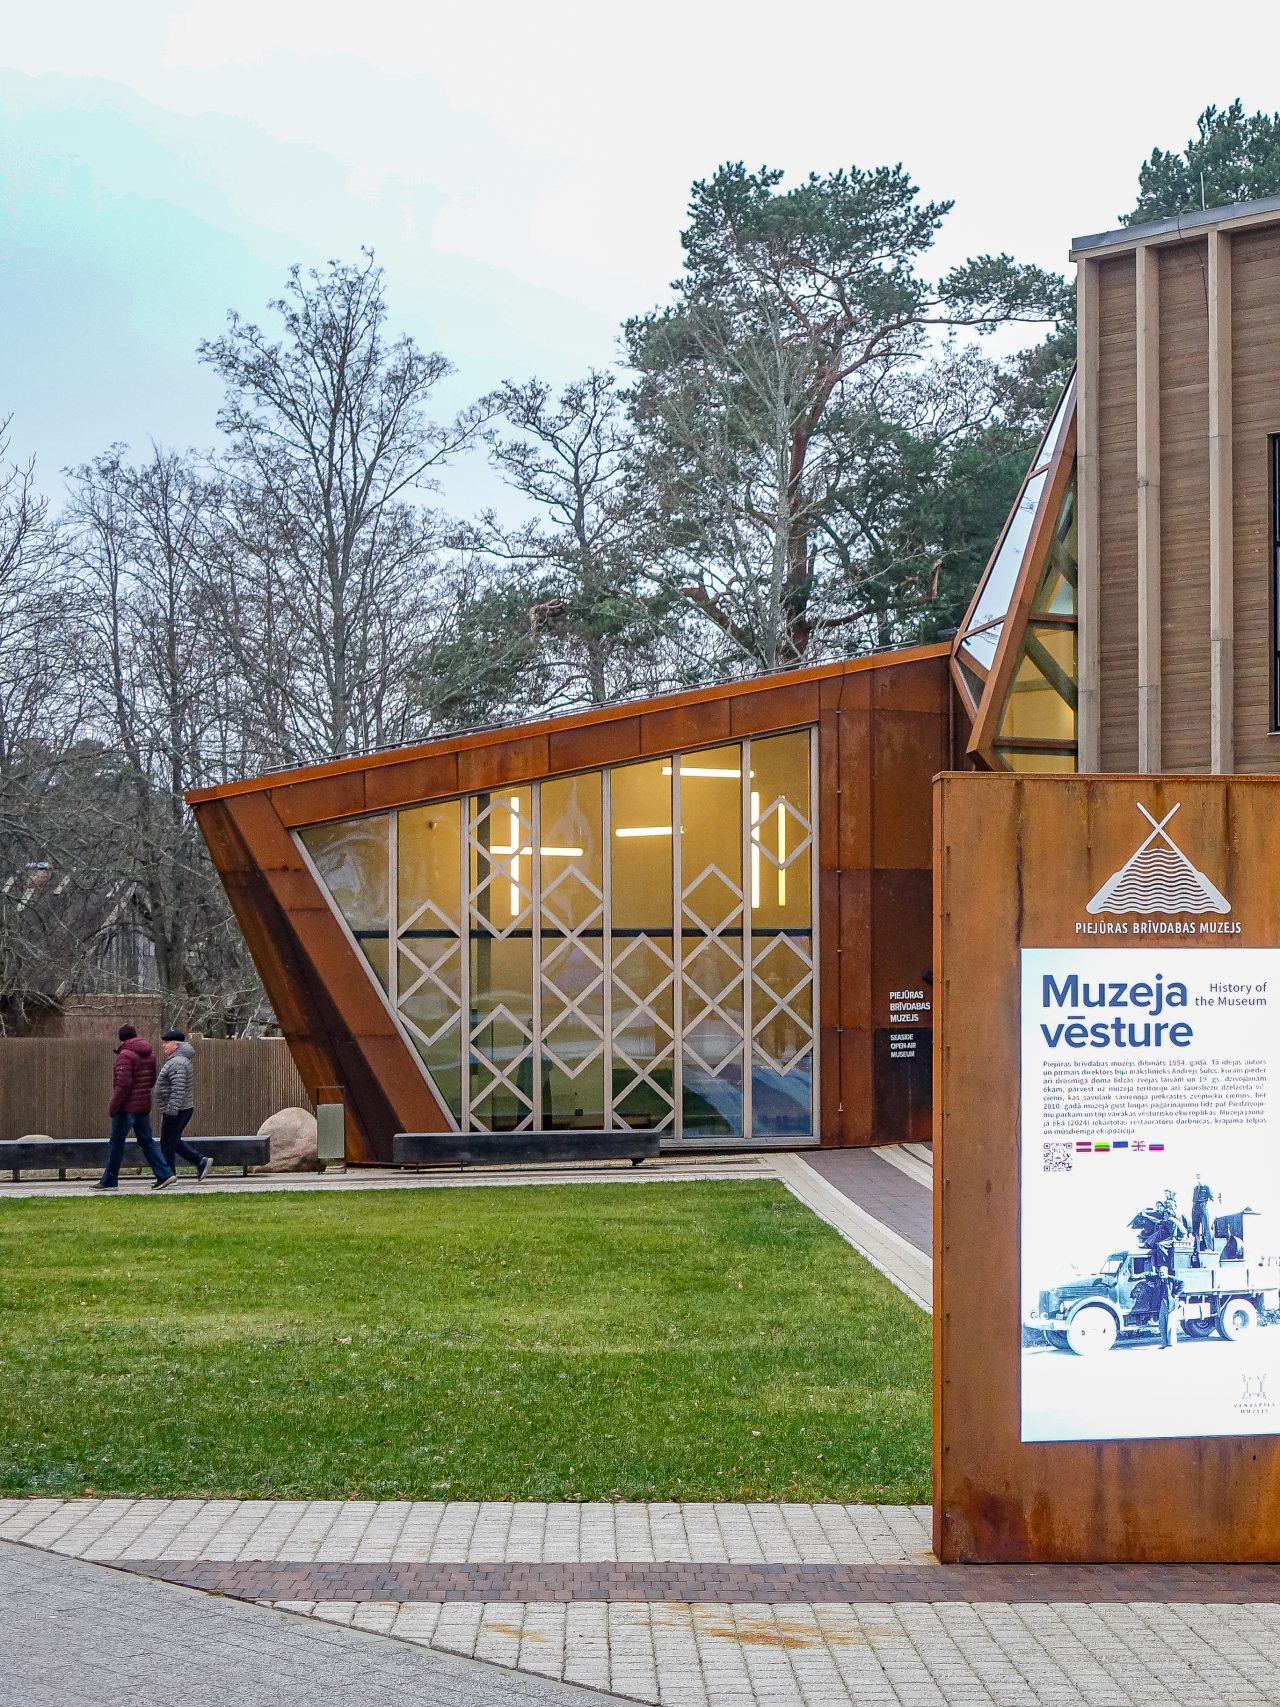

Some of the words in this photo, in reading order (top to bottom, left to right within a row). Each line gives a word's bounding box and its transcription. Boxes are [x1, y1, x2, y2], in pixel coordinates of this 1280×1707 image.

[1075, 920, 1128, 934] PIEJŪRAS
[1133, 920, 1196, 934] BRĪVDABAS
[1199, 921, 1242, 934] MUZEJS
[1210, 982, 1252, 994] History
[1255, 982, 1268, 992] of
[889, 990, 924, 999] PIEJŪRAS
[1043, 974, 1187, 1015] Muzeja
[889, 1002, 931, 1011] BRĪVDABAS
[1194, 996, 1215, 1006] the
[1218, 996, 1267, 1006] Museum
[890, 1014, 919, 1022] MUZEJS
[1040, 1015, 1193, 1048] vēsture
